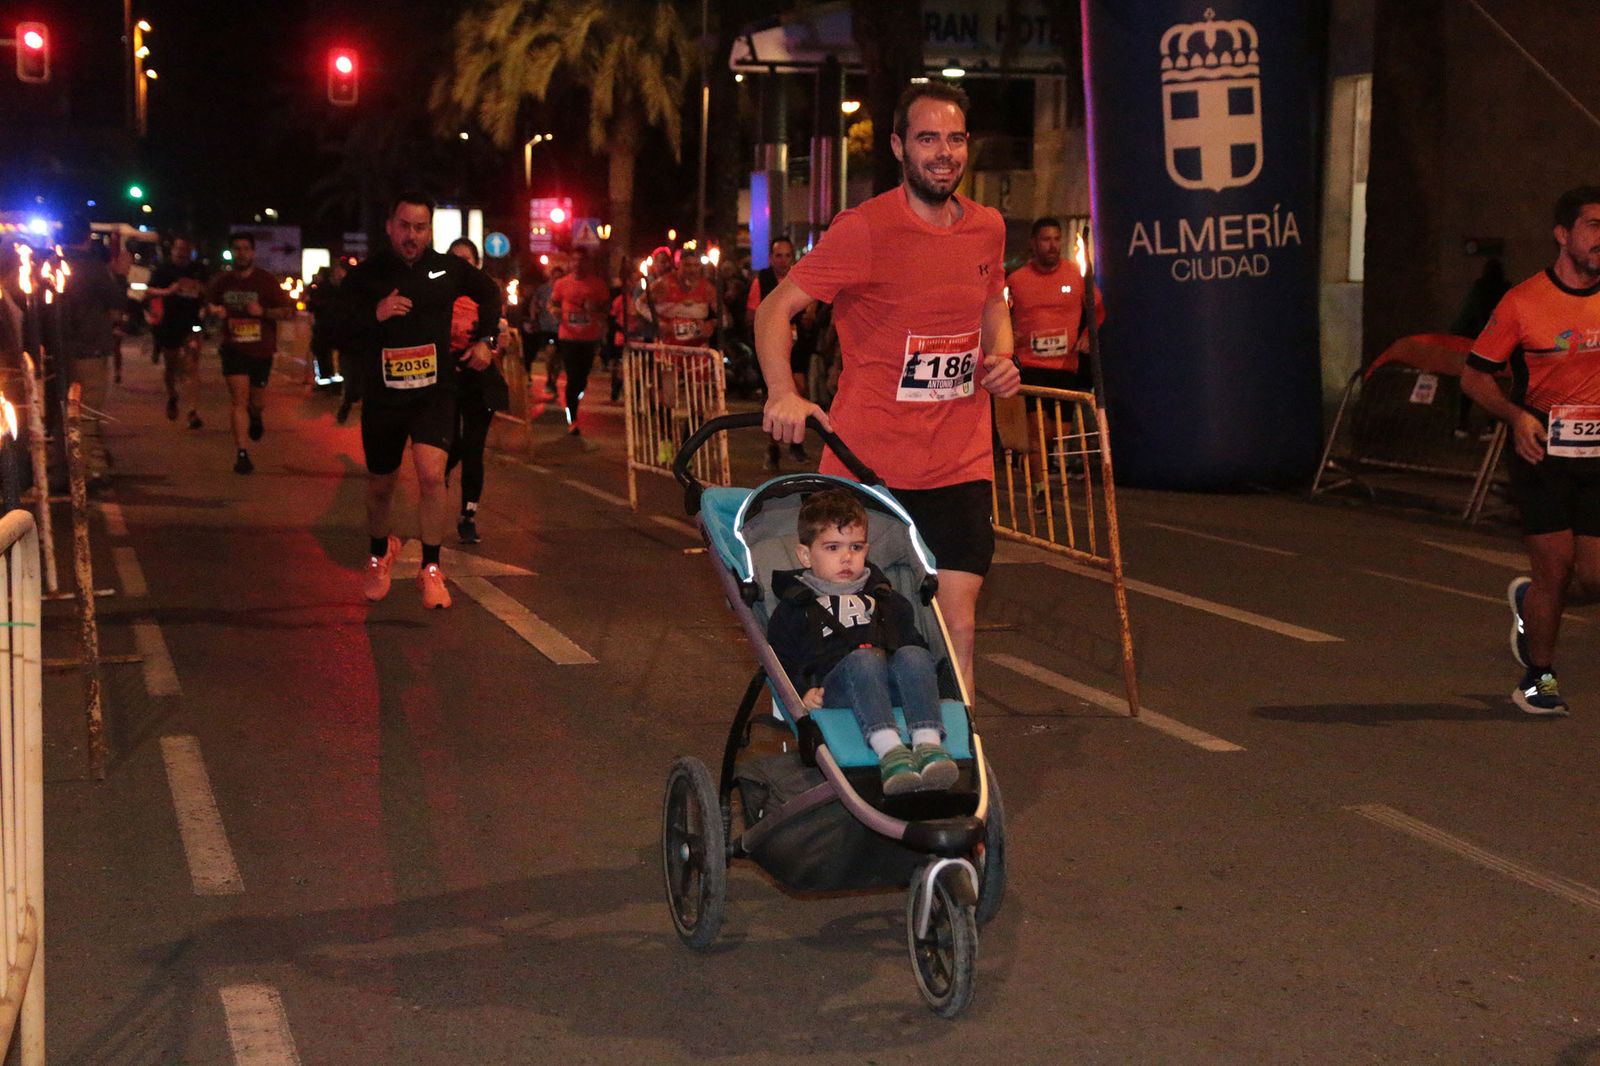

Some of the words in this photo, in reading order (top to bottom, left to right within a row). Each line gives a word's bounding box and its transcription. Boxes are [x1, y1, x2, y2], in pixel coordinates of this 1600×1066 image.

[1128, 203, 1302, 257] ALMERÍA
[1171, 253, 1270, 282] CIUDAD
[395, 358, 430, 372] 2036
[927, 353, 973, 379] 186
